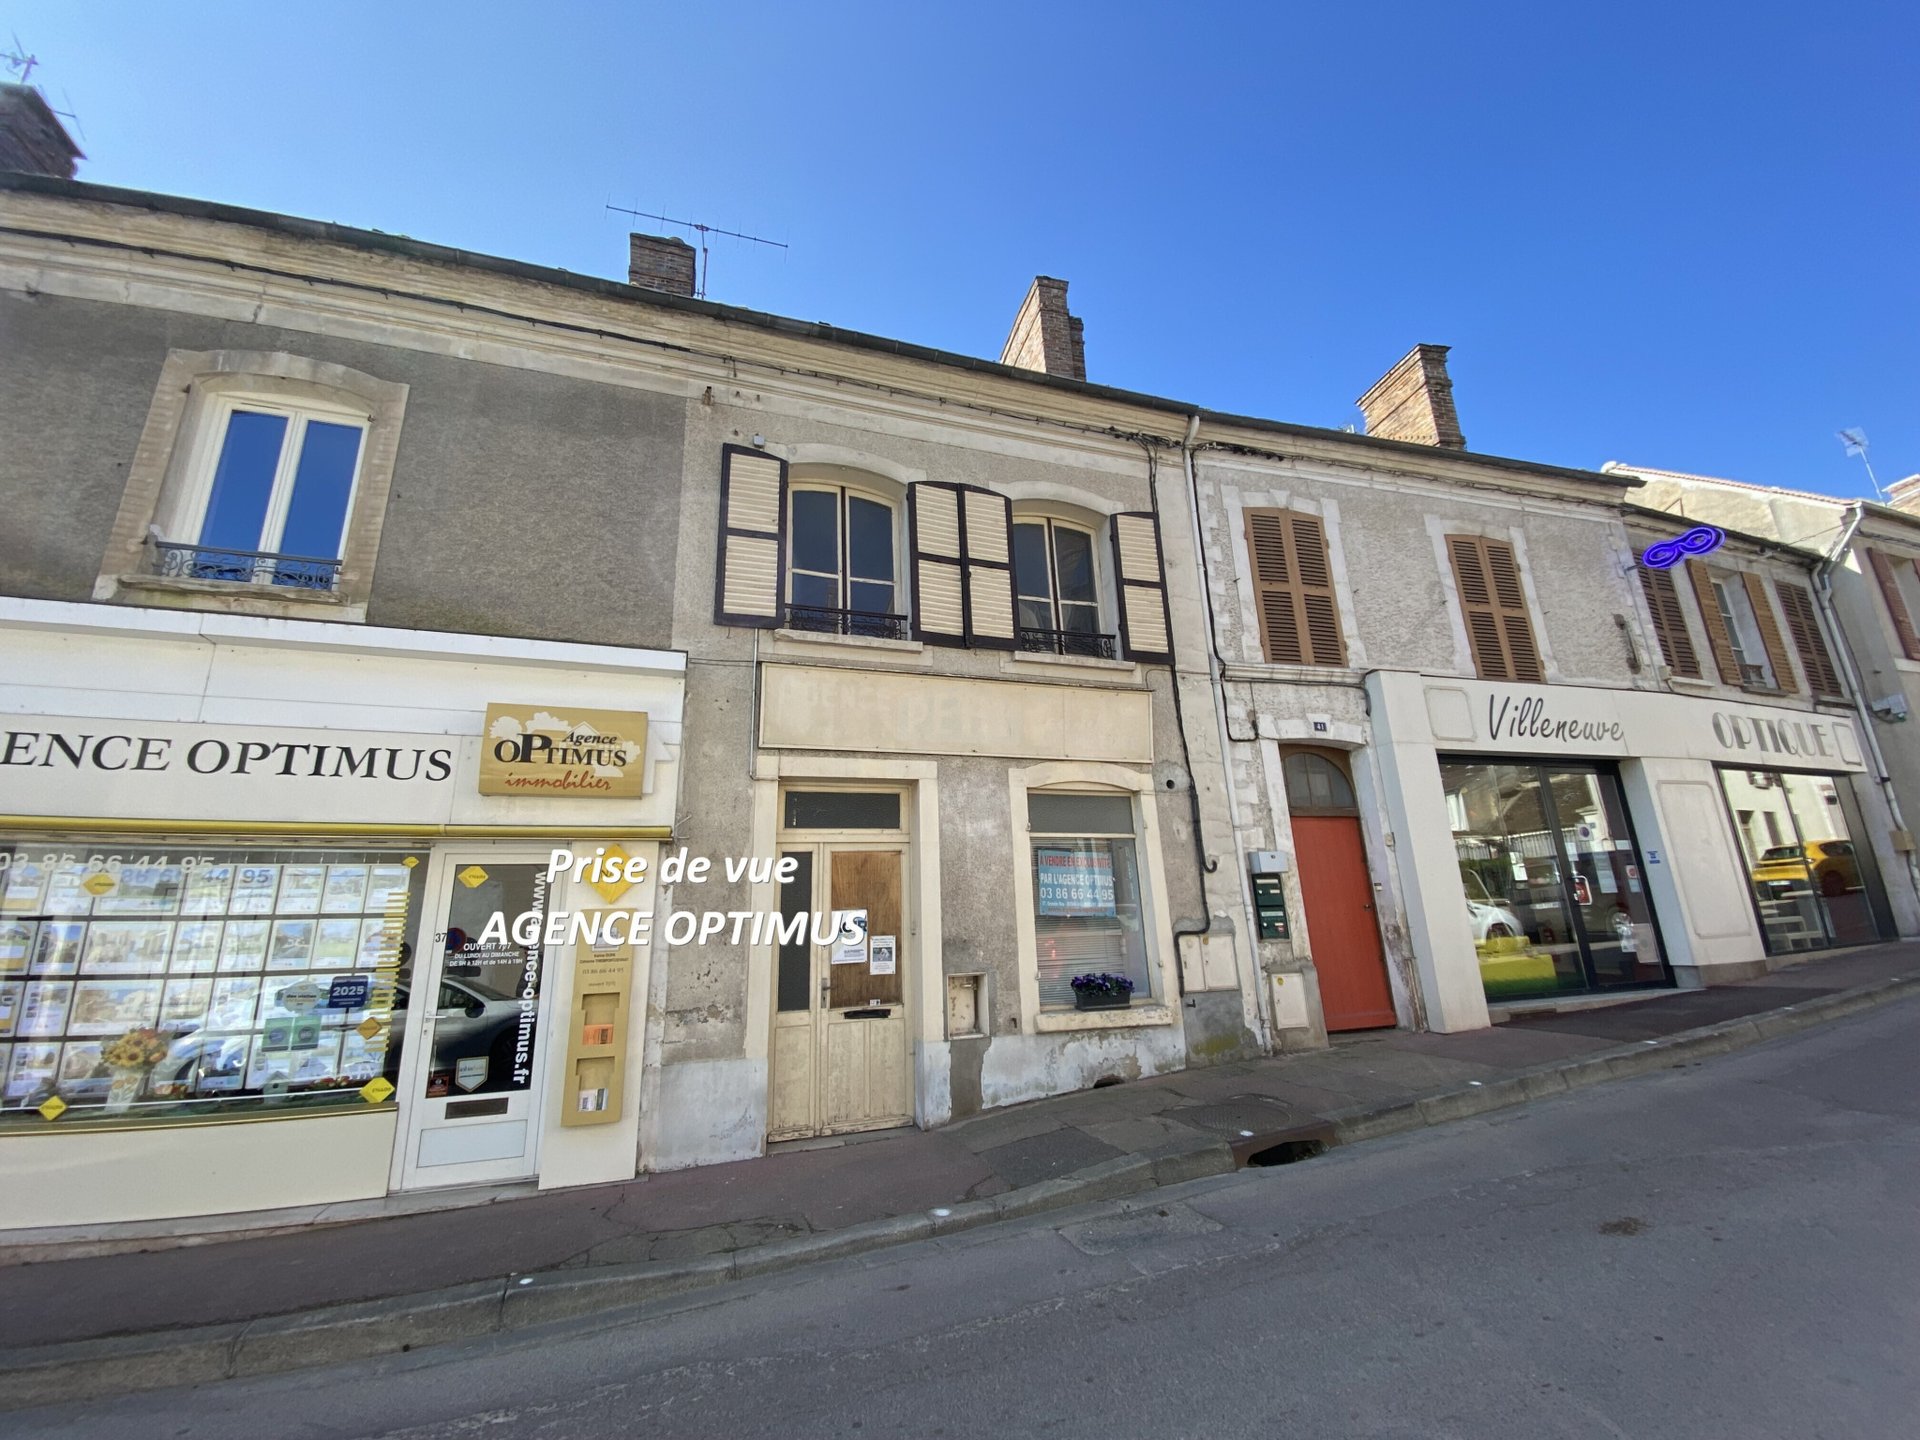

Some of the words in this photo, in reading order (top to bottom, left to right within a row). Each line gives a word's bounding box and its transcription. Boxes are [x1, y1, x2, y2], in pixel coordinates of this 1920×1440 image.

[1489, 694, 1624, 742] Villeneuve
[562, 732, 618, 746] Agence
[1712, 712, 1833, 757] OPTIQUE
[0, 731, 172, 771] ENCE
[187, 739, 451, 781] OPTIMUS
[505, 770, 612, 790] immobilier
[88, 855, 122, 872] 66
[1041, 888, 1052, 899] 03
[1056, 888, 1068, 899] 86
[1071, 888, 1083, 899] 66
[1087, 889, 1099, 899] 44
[1102, 889, 1114, 900] 95
[435, 933, 447, 942] 37
[463, 942, 497, 951] OUVERT
[513, 872, 546, 1084] wwwaence-optimus.fr
[332, 986, 364, 996] 2025
